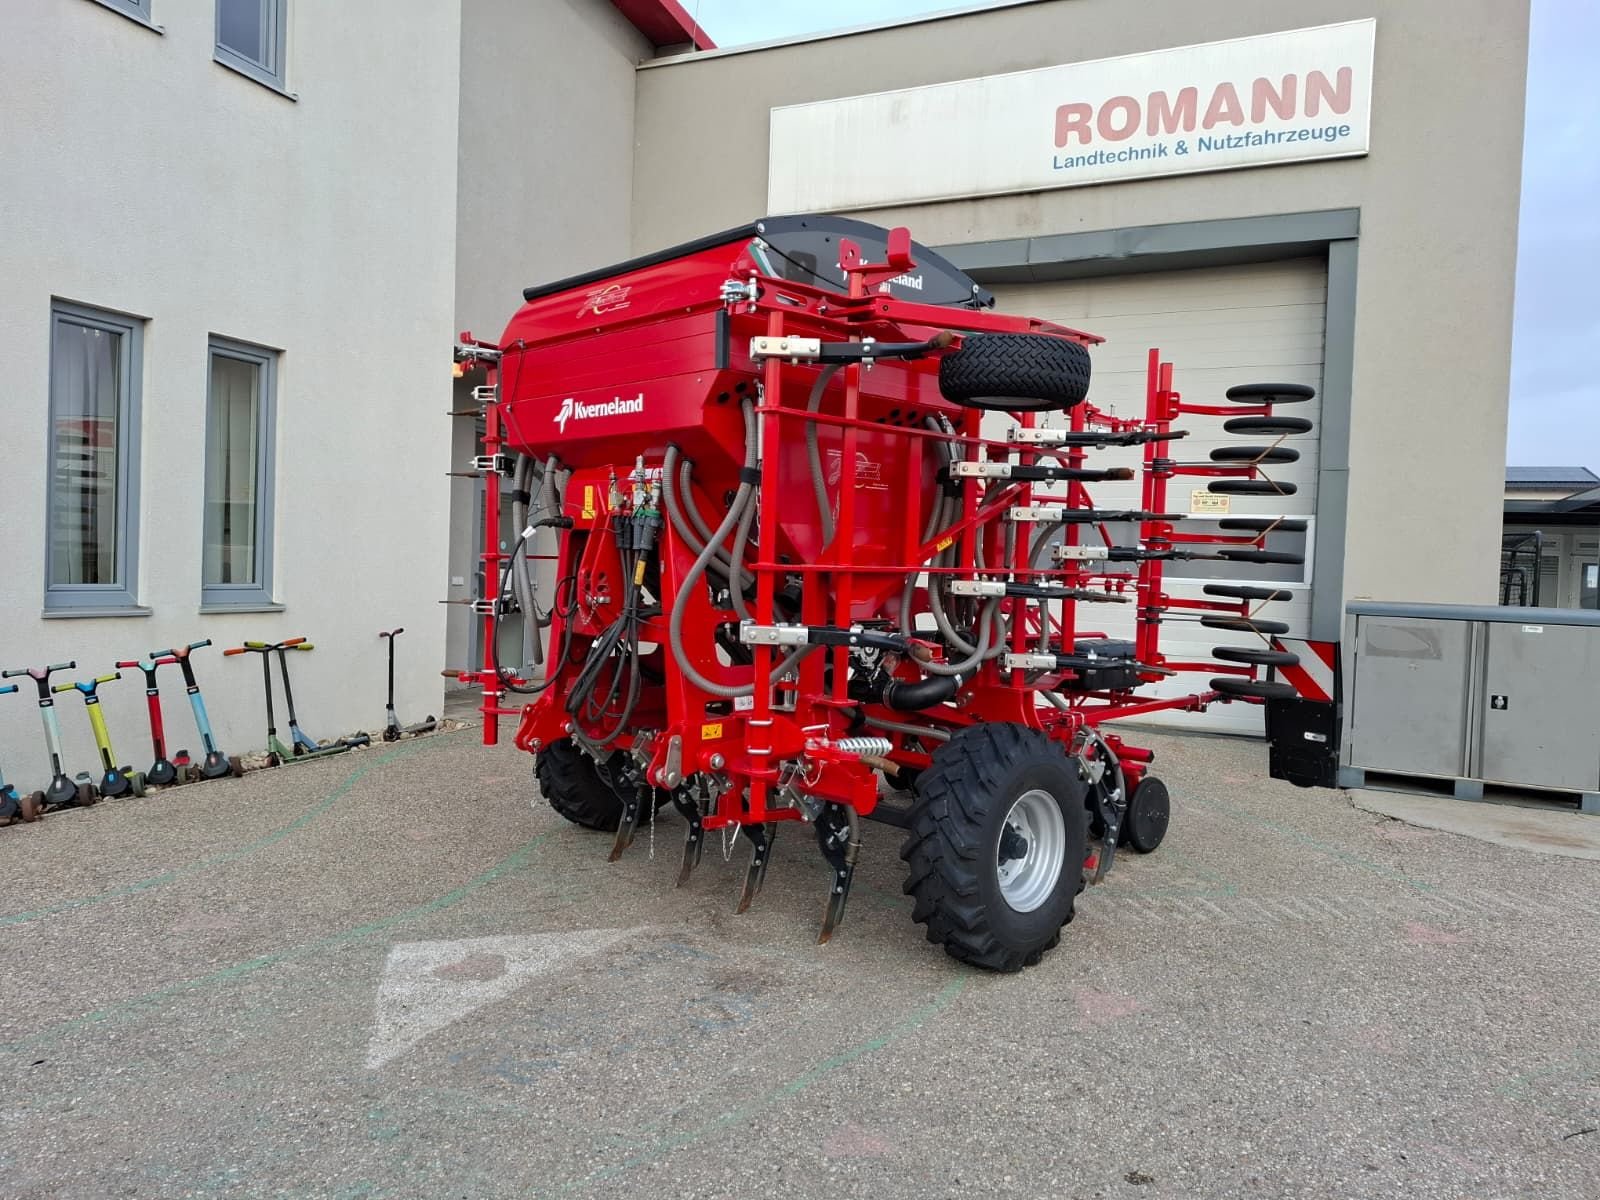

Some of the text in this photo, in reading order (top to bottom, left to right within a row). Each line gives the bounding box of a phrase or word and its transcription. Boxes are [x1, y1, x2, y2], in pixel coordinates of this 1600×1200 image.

[1054, 66, 1353, 148] ROMANN
[1053, 124, 1351, 170] Landtechnik & Nutzfahrzeuge
[574, 392, 644, 420] Kverneland
